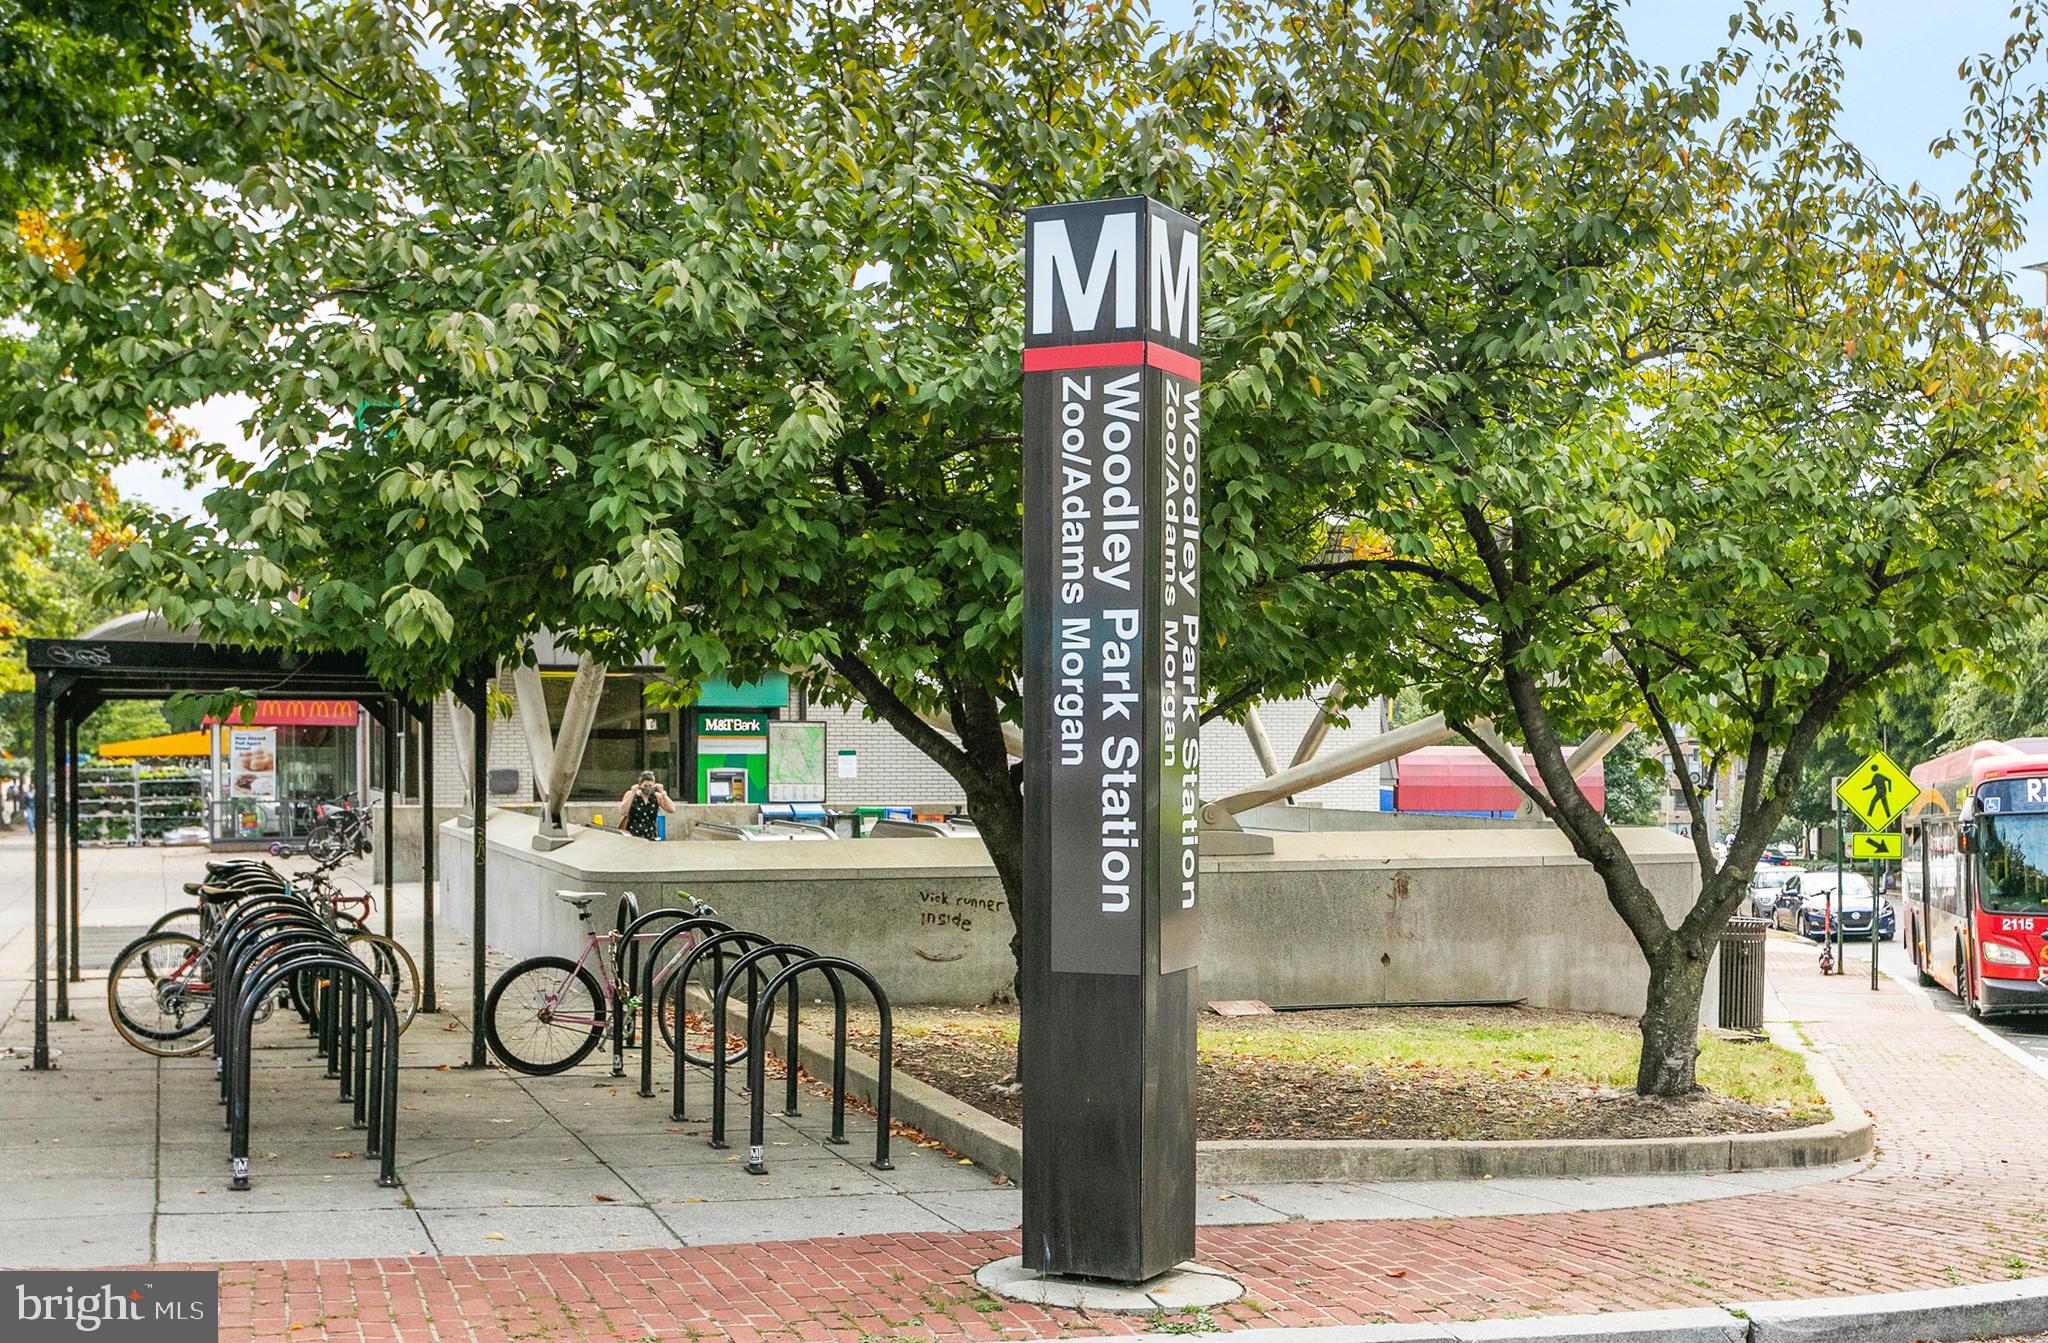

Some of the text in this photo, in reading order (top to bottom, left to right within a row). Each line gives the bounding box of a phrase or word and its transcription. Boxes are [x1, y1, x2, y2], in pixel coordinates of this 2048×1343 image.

[1033, 212, 1137, 335] M
[1151, 213, 1199, 346] M
[1054, 375, 1091, 766] Zoo/Adams Morgan
[1162, 378, 1180, 767] Zoo/Adams Morgan
[1093, 372, 1140, 913] Woodley Park Station
[1179, 389, 1200, 910] Woodley Park Station
[705, 718, 760, 731] M&T Bank
[956, 897, 1004, 912] runner
[2002, 919, 2034, 930] 2115
